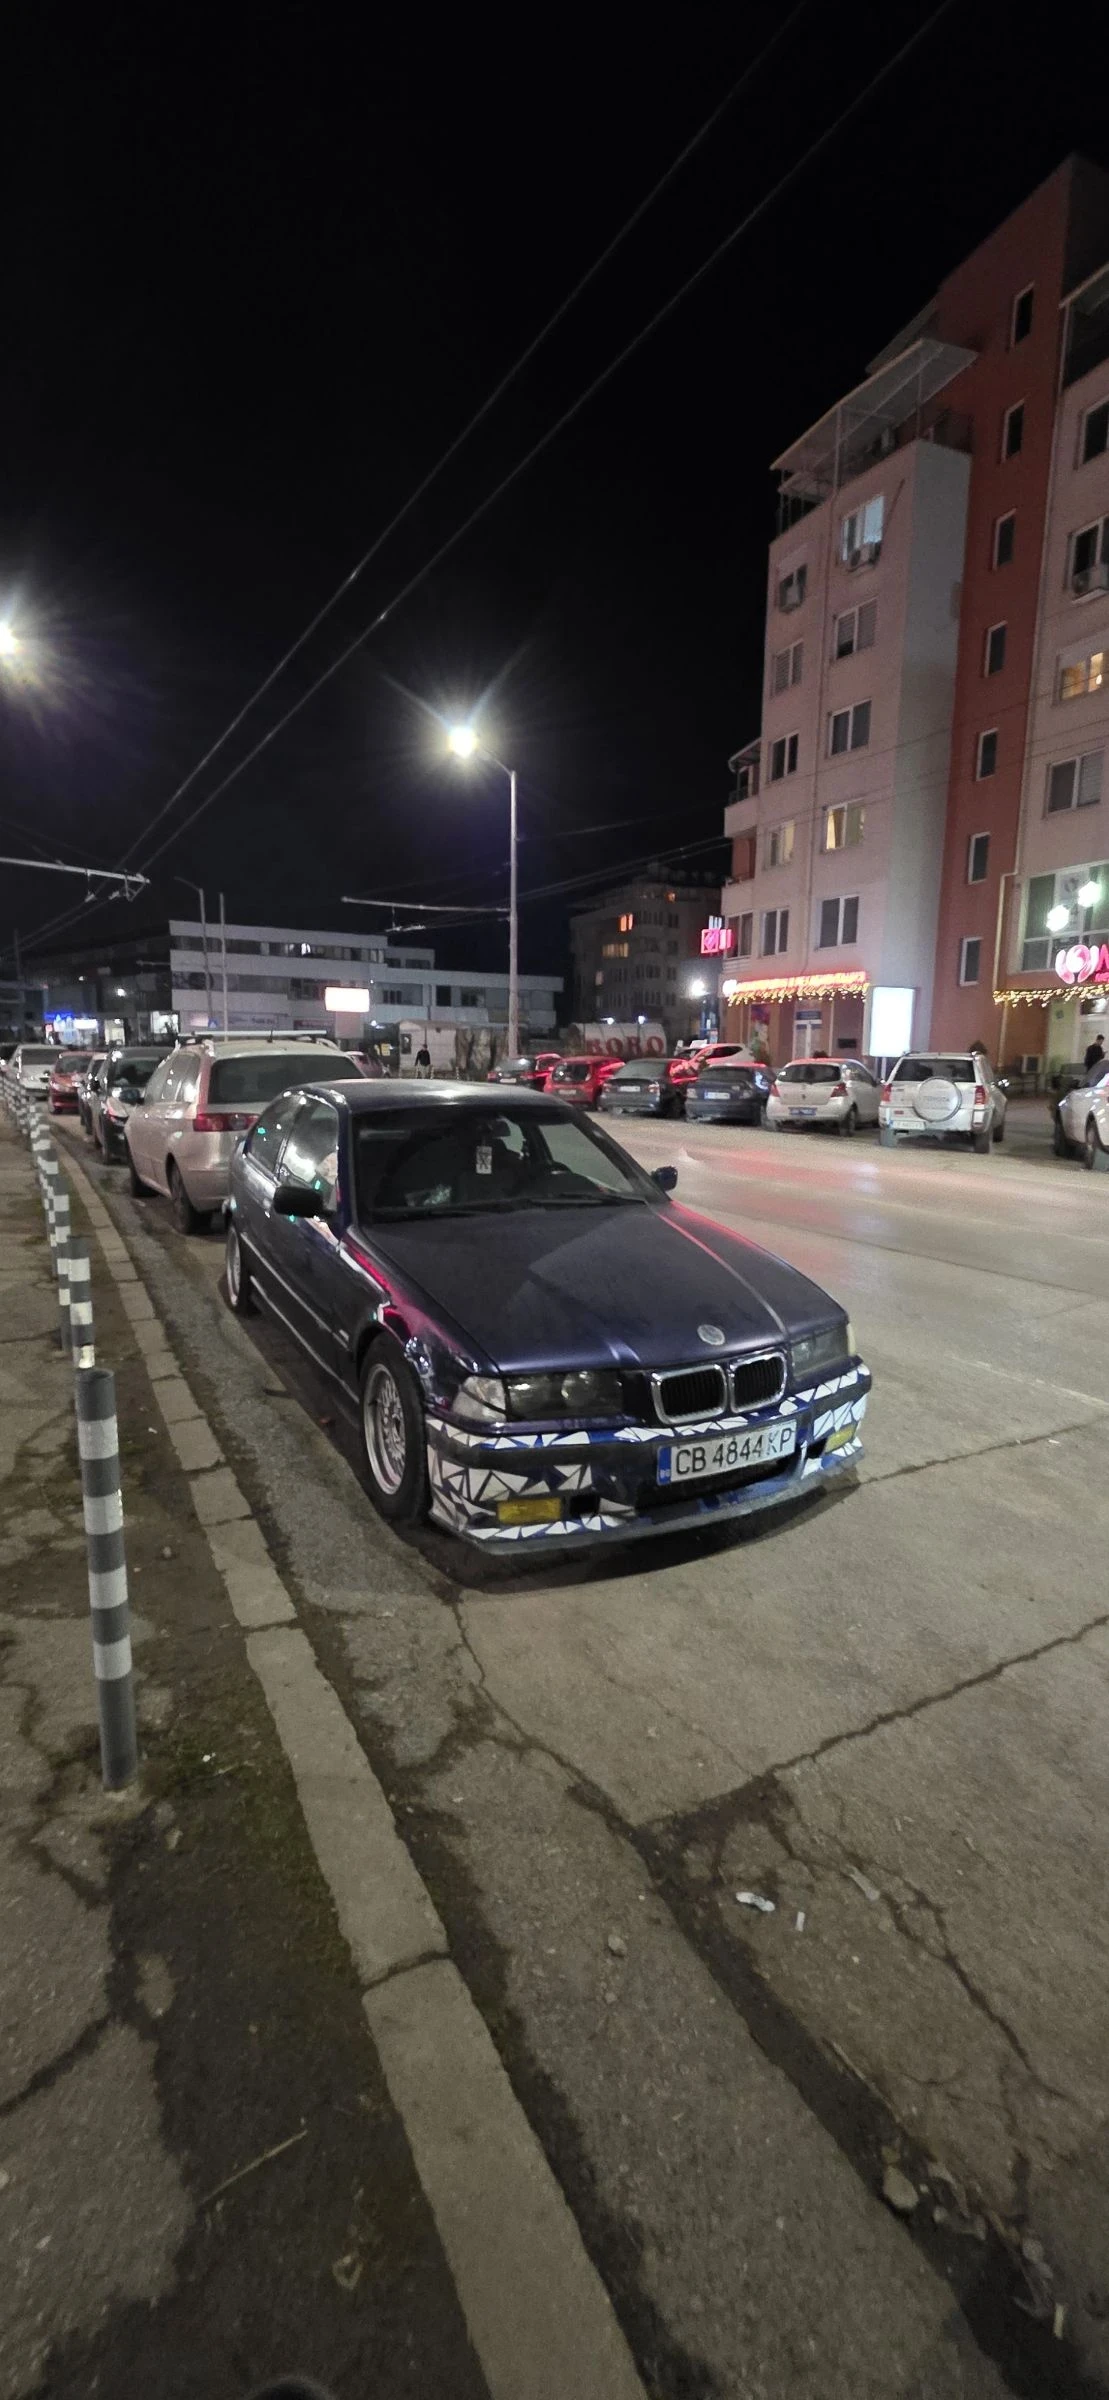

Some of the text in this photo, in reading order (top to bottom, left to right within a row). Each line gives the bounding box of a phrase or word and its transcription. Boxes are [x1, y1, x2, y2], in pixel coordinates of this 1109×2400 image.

[676, 1426, 793, 1475] CB 4844 KP
